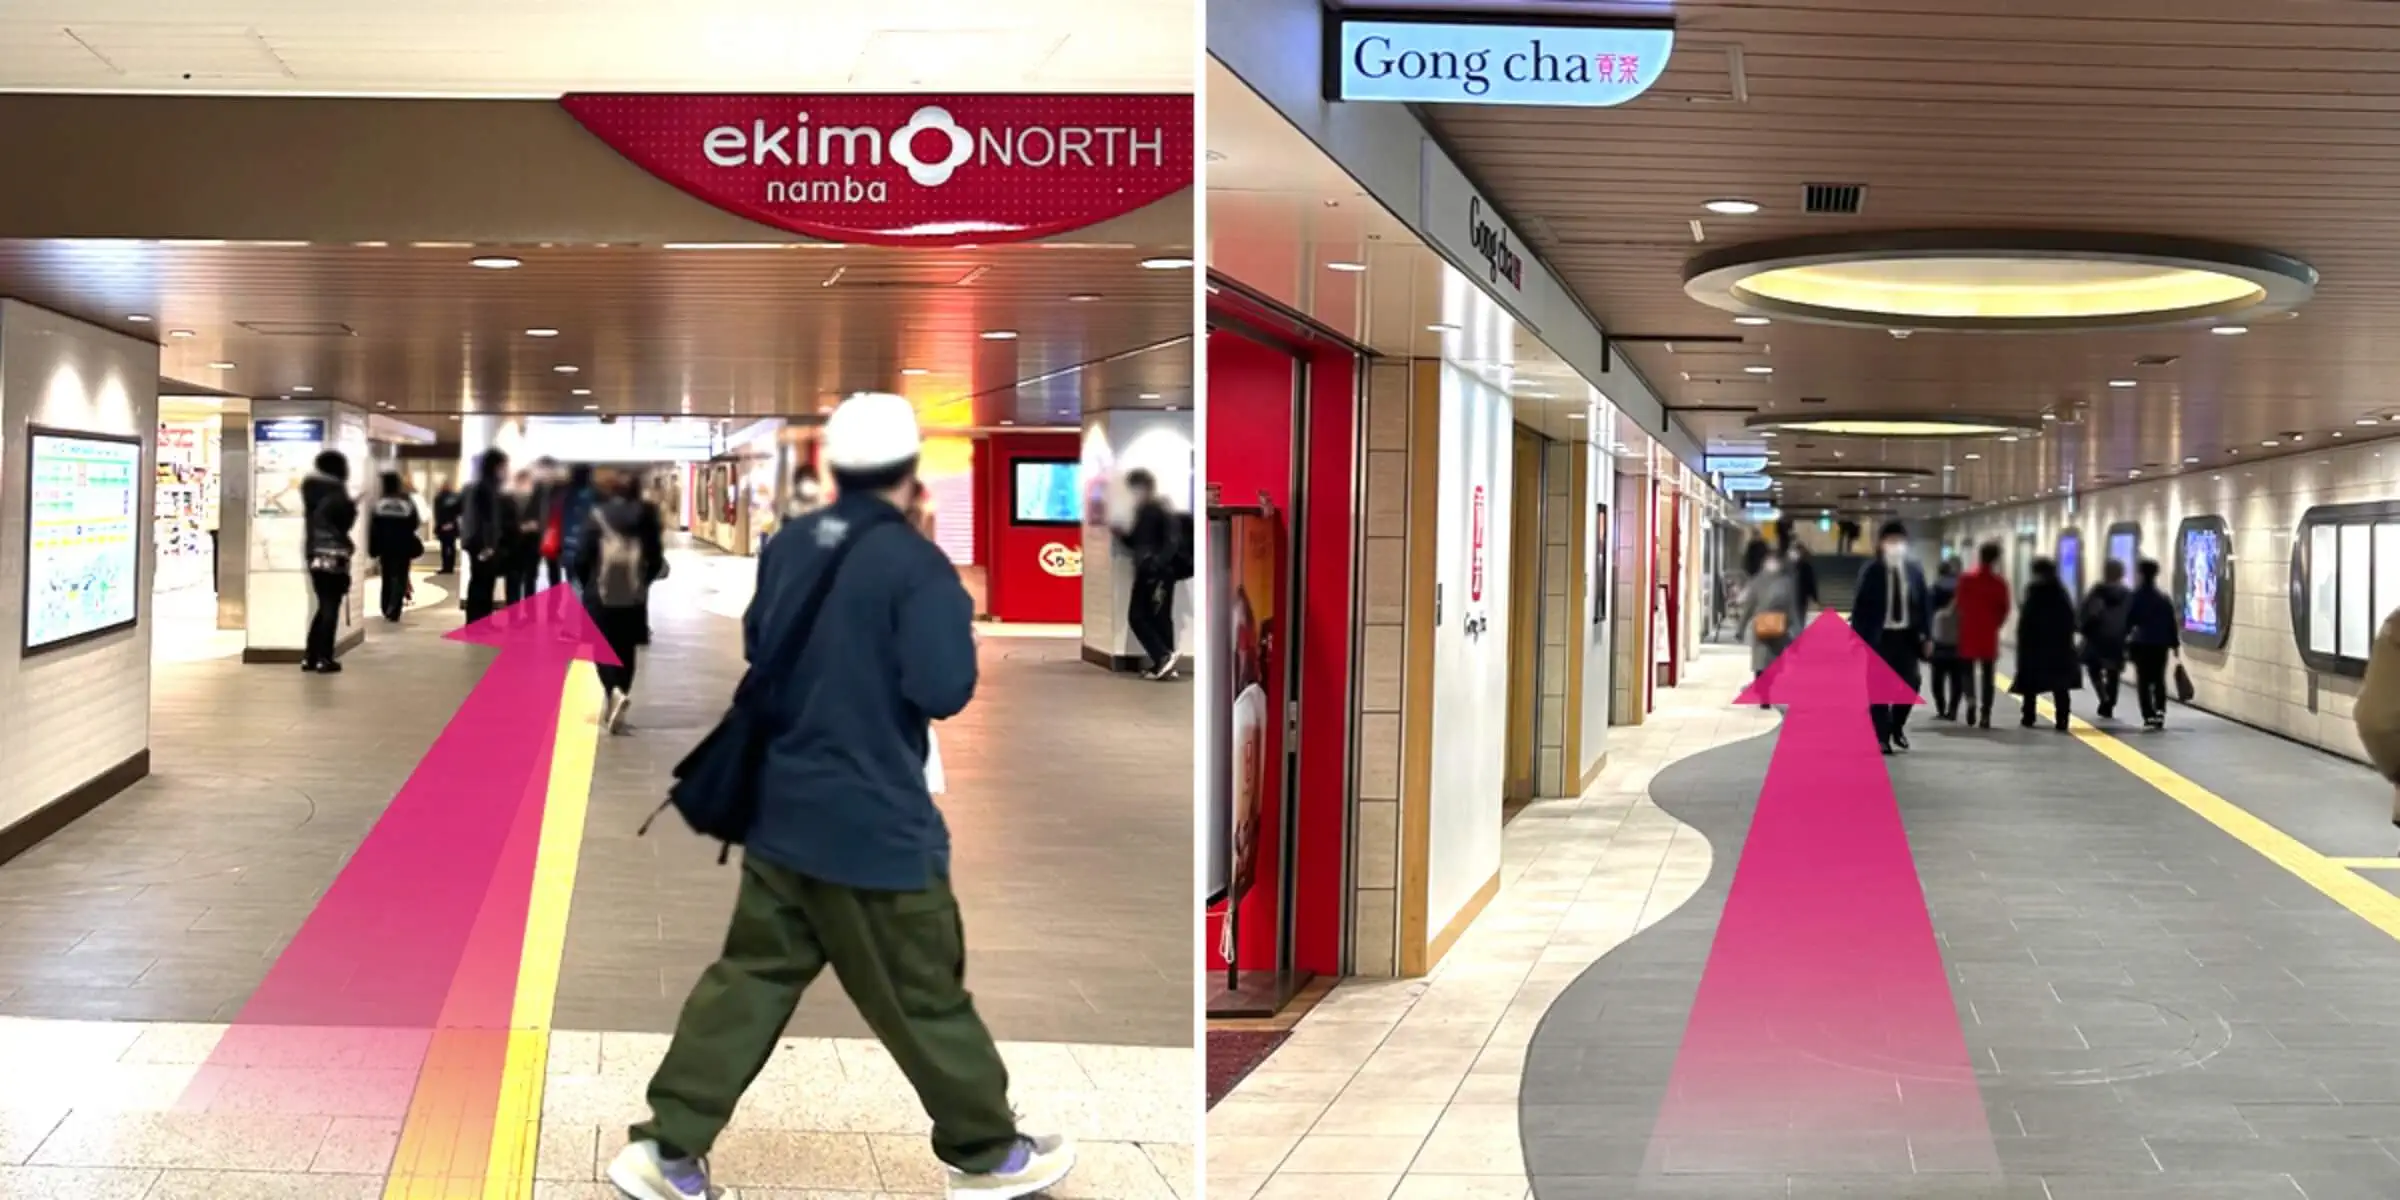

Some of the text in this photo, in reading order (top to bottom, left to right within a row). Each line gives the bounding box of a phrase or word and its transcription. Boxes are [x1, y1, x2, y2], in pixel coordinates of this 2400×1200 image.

[1354, 36, 1591, 95] Gong cha
[979, 127, 1164, 167] NORTH
[767, 176, 887, 203] namba
